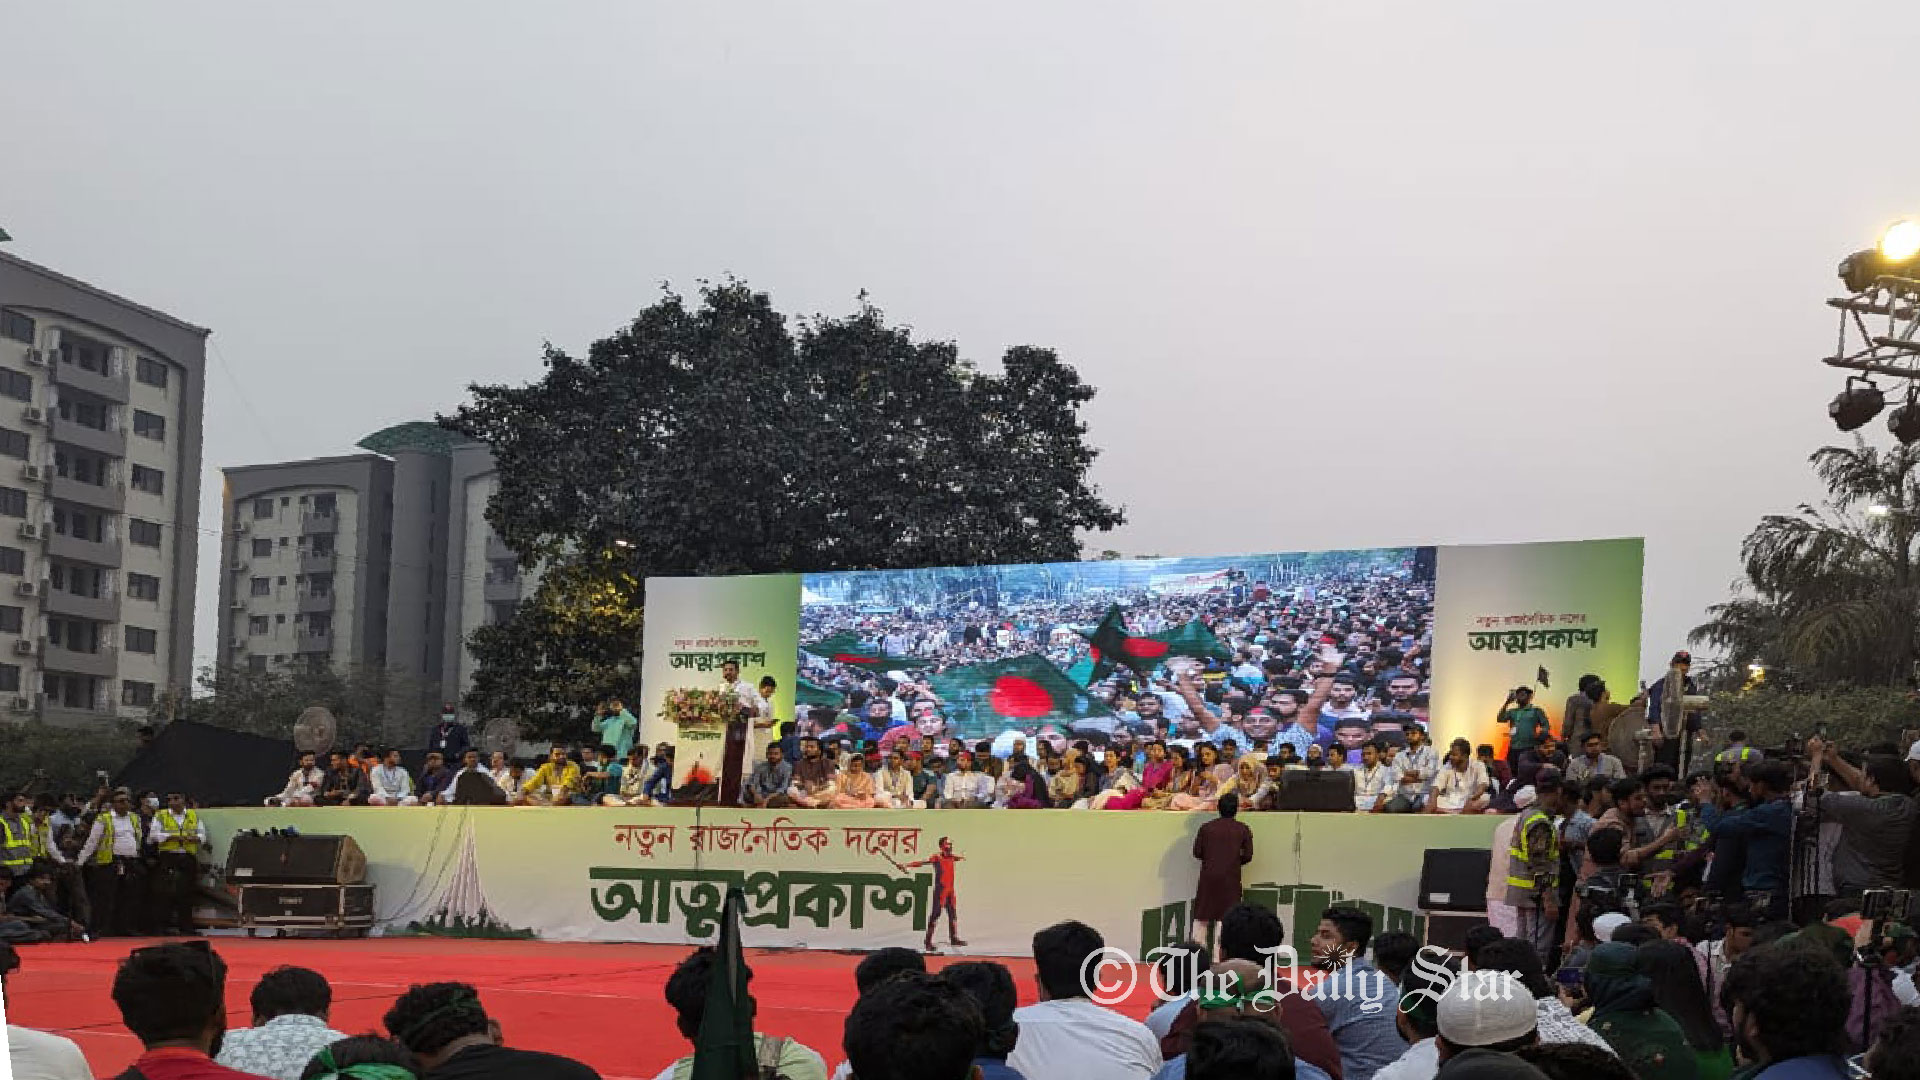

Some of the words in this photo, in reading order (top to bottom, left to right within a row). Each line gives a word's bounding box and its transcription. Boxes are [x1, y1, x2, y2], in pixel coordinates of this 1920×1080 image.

[1467, 628, 1598, 653] আত্মপ্রকাশ
[614, 824, 676, 858] নতুন
[687, 817, 830, 855] রাজনৈতিক
[842, 827, 921, 855] দলের
